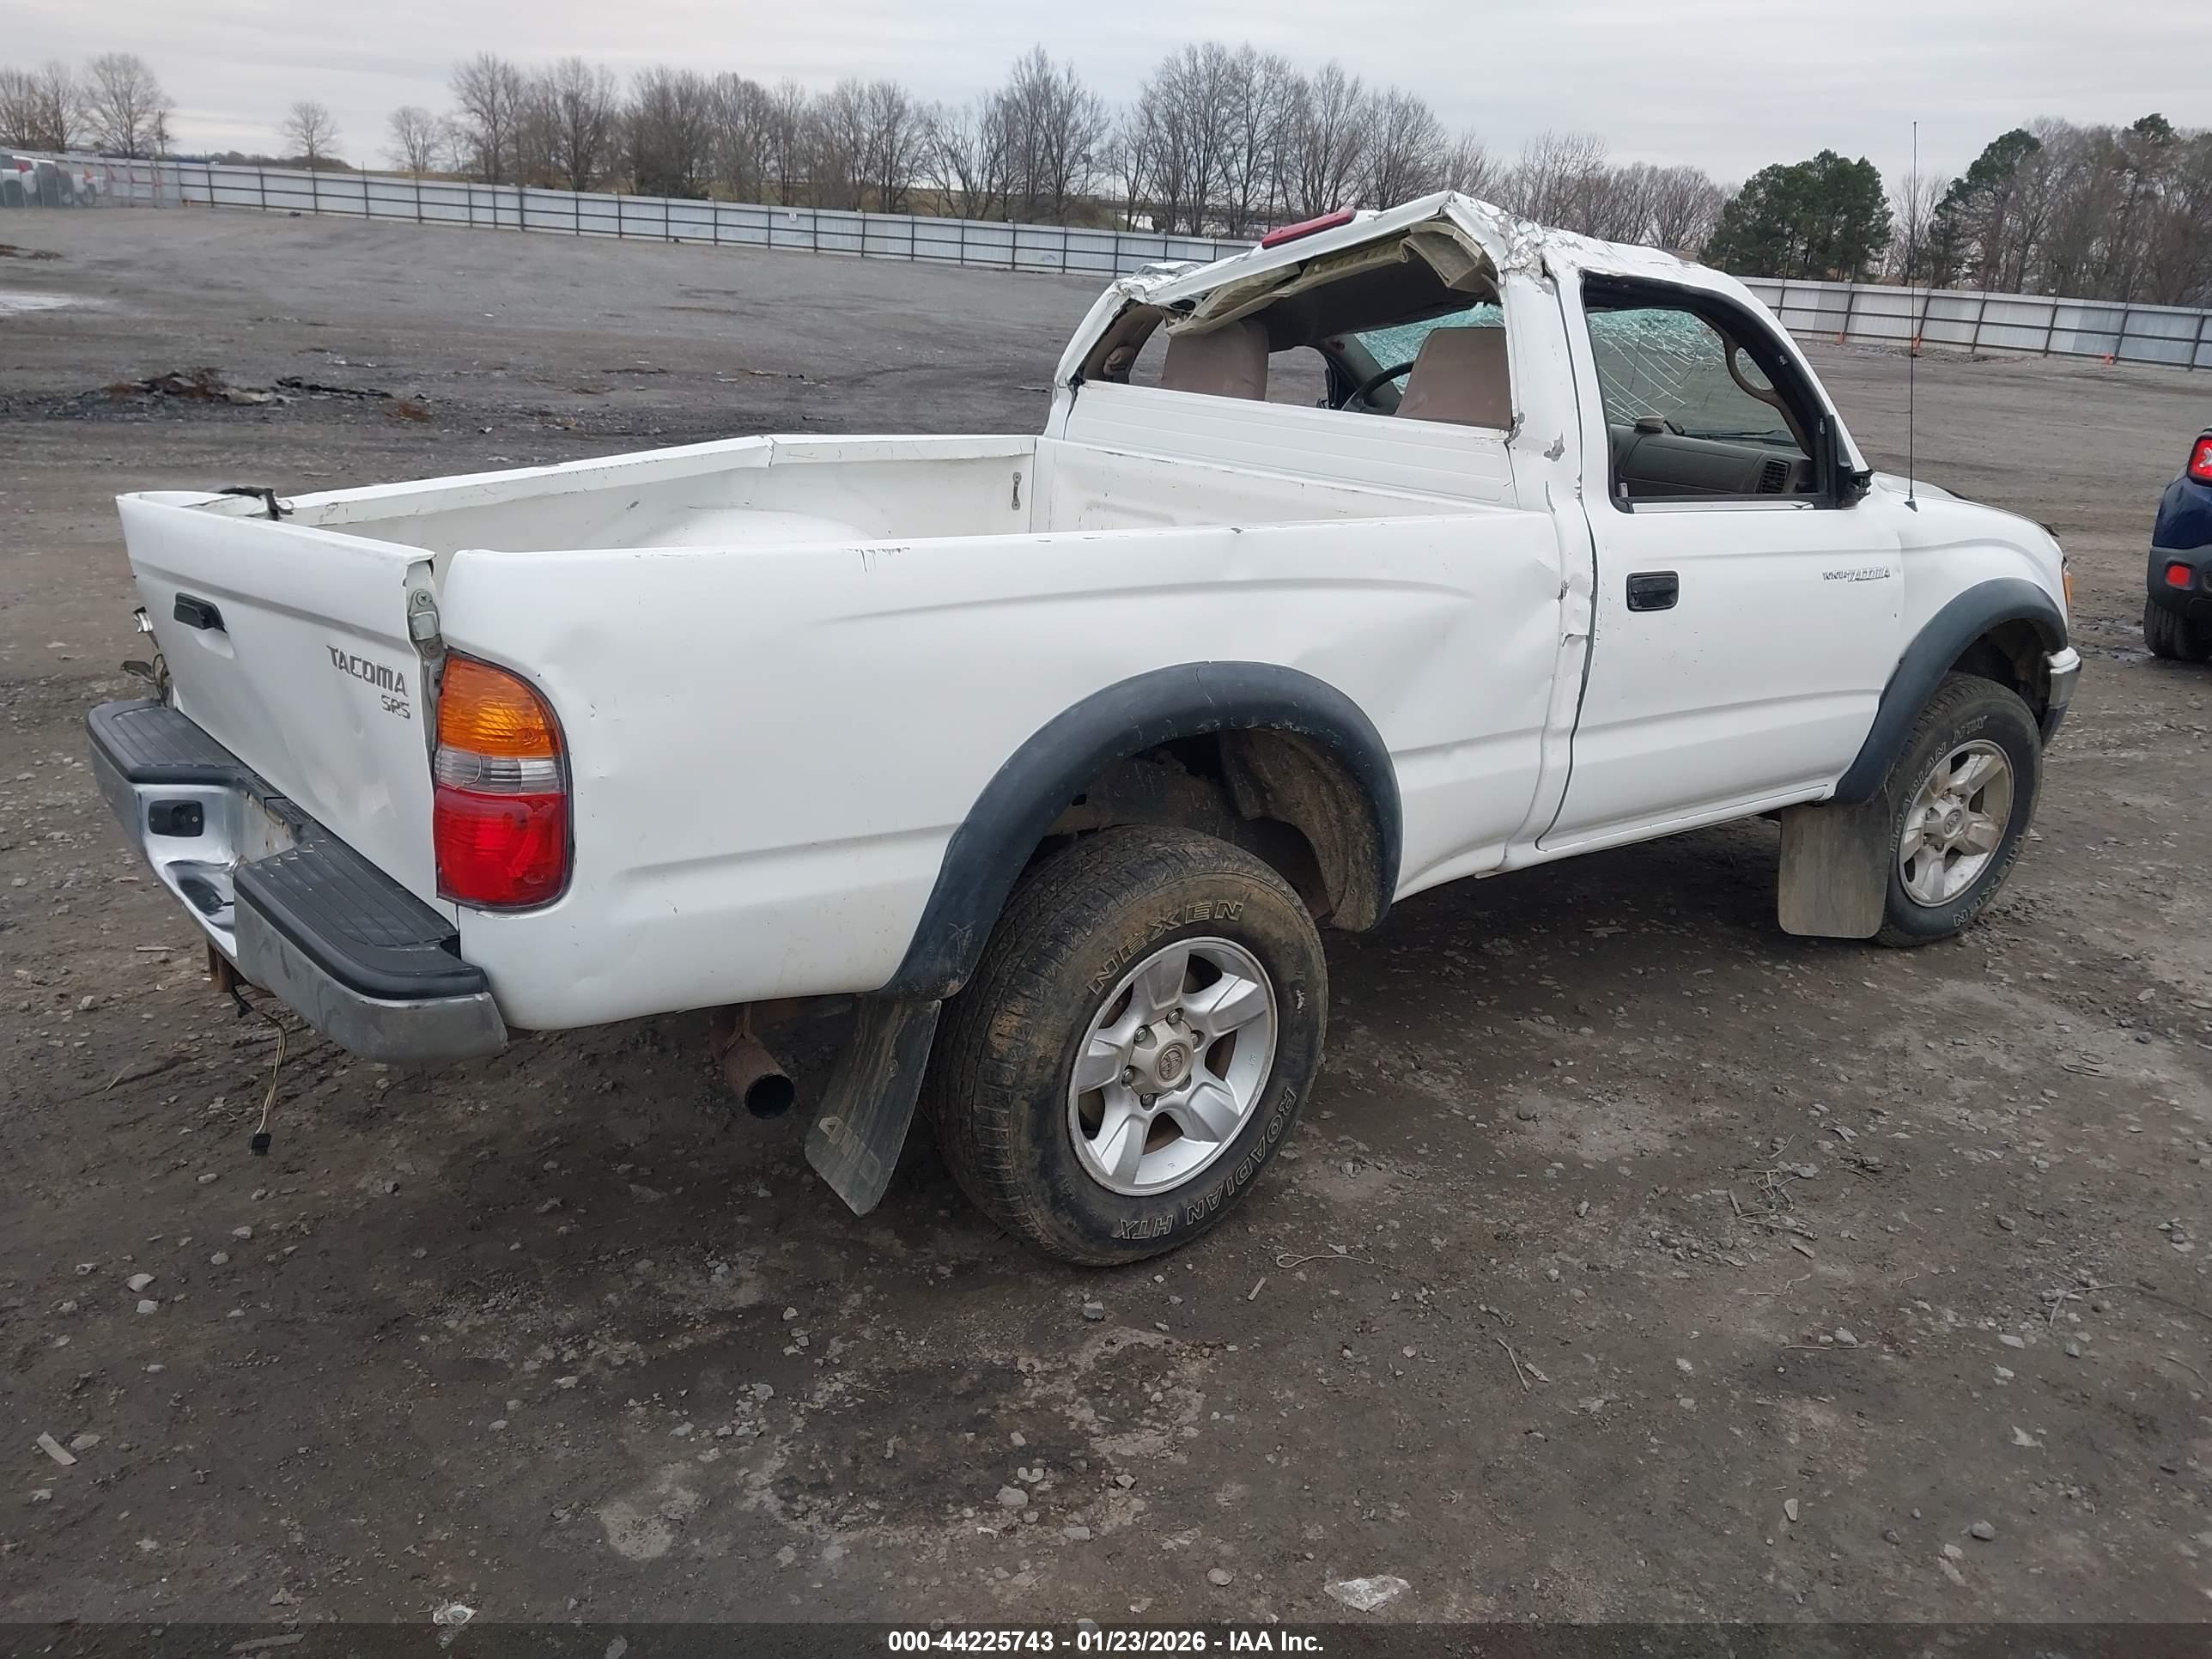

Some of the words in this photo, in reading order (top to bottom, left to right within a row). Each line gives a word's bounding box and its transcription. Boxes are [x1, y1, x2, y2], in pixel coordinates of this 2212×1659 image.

[326, 645, 409, 697] TACOMA
[1086, 899, 1244, 996] NEXEN
[1187, 1085, 1297, 1226] ROADIAN
[1111, 1215, 1175, 1240] HTX
